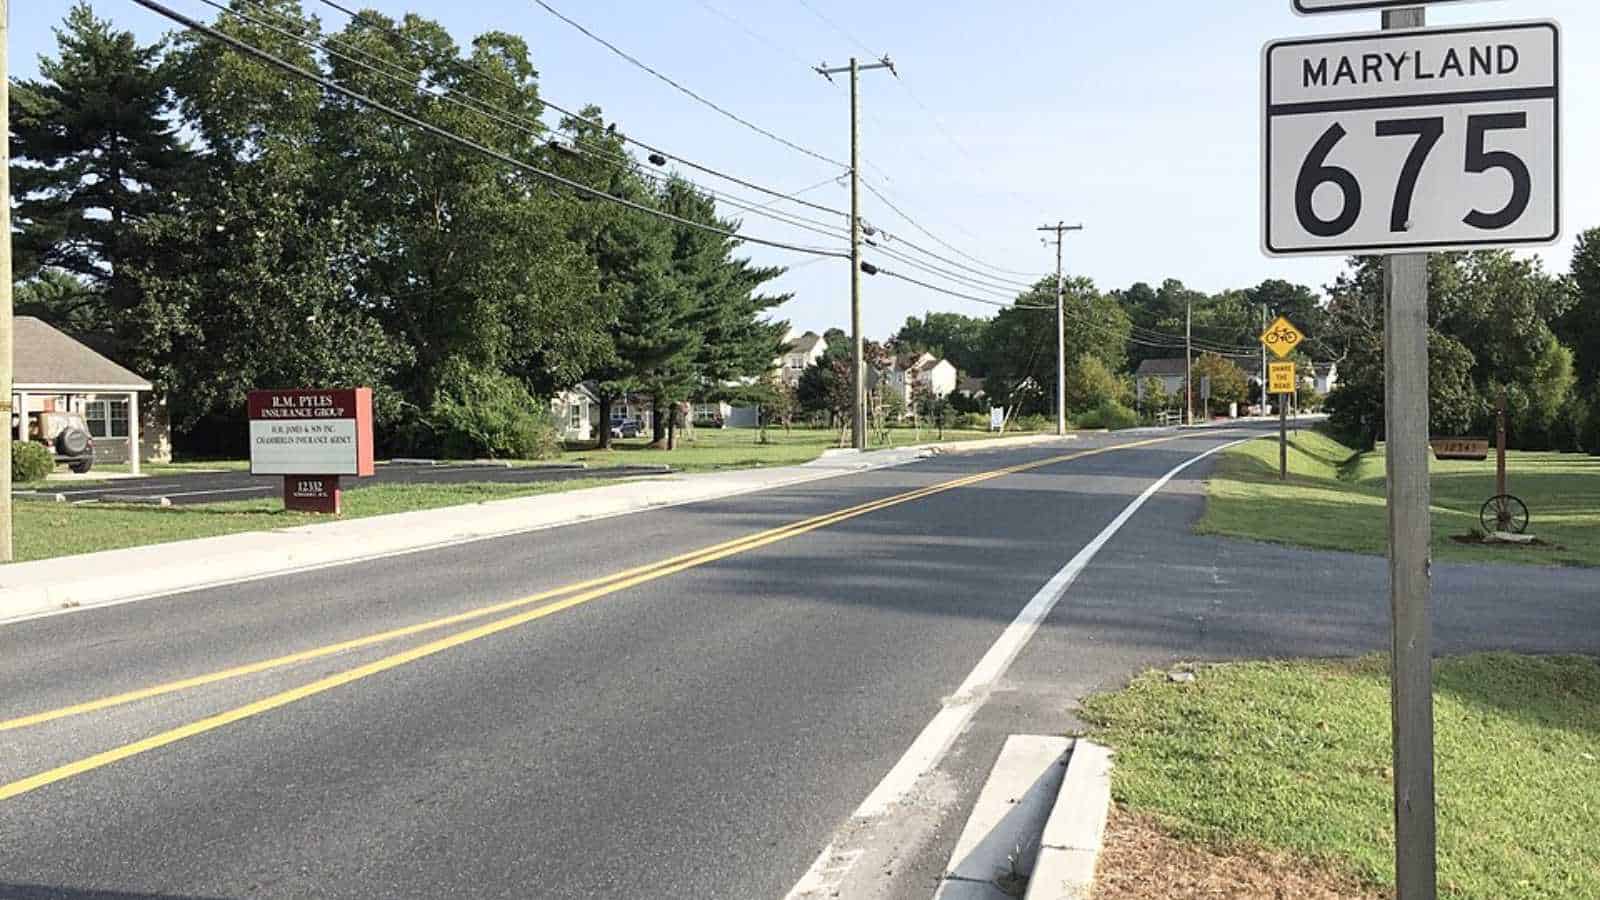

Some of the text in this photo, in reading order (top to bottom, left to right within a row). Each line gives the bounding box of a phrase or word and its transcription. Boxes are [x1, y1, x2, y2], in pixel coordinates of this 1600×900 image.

[1303, 44, 1519, 87] MARYLAND
[1294, 111, 1532, 238] 675
[299, 395, 332, 406] PYLES
[262, 407, 344, 417] INSURANCE GROUP
[295, 436, 328, 444] INSURANCE
[330, 435, 351, 443] AGENCY
